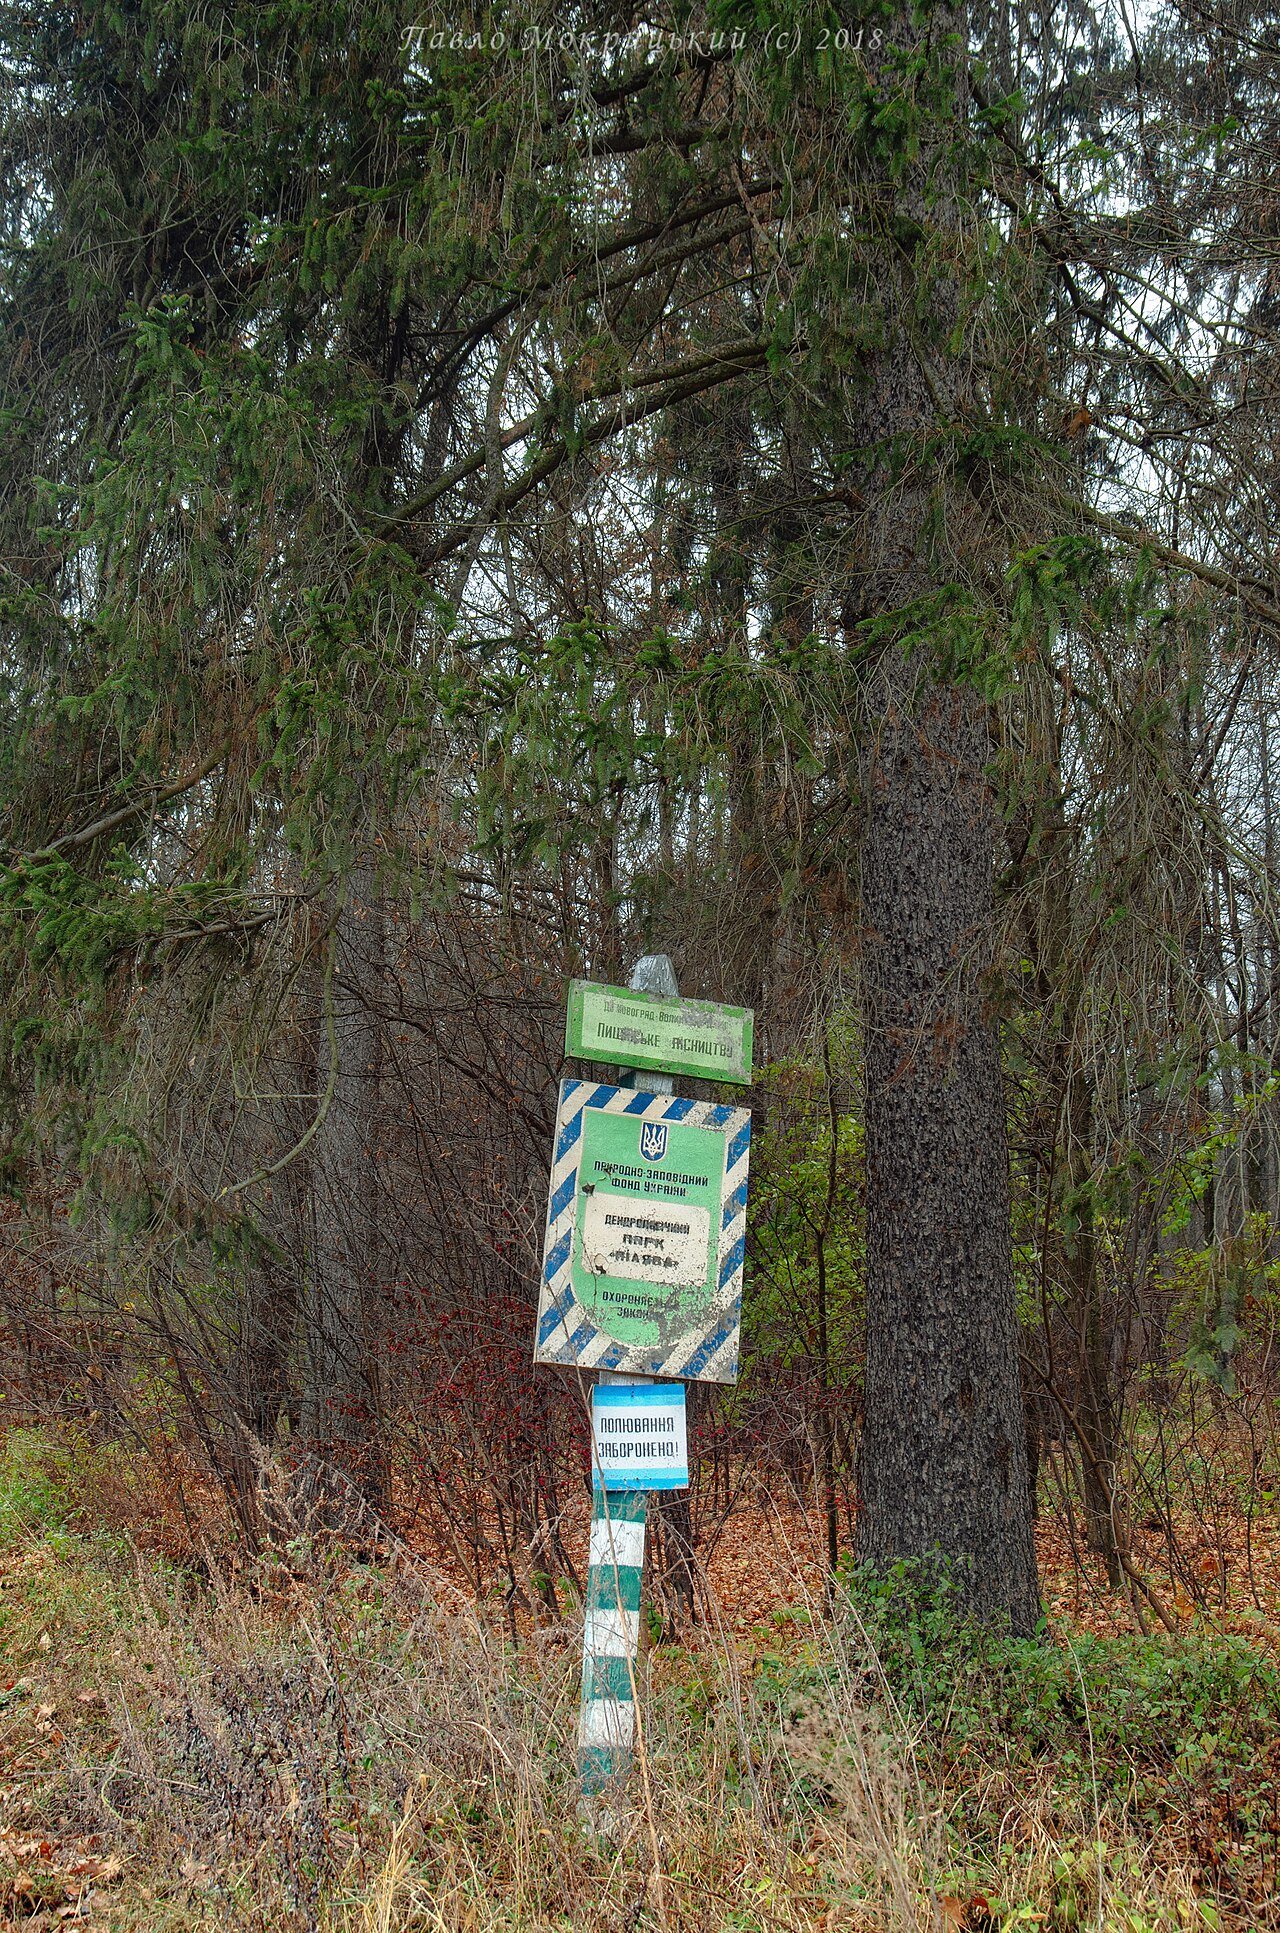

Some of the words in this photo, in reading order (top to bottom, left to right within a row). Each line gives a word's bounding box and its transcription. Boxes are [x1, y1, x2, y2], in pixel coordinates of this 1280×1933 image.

[597, 1022, 660, 1047] ПИЩЬКЕ
[594, 1160, 709, 1187] ПРИРОДНО-ЗАПОВІДНИЙ
[611, 1178, 641, 1191] ФОНД
[644, 1181, 687, 1197] УКРАЇНИ
[600, 1417, 674, 1433] ПОЛЮВАННЯ
[598, 1441, 679, 1457] ЗАБОРОНЕНО!
